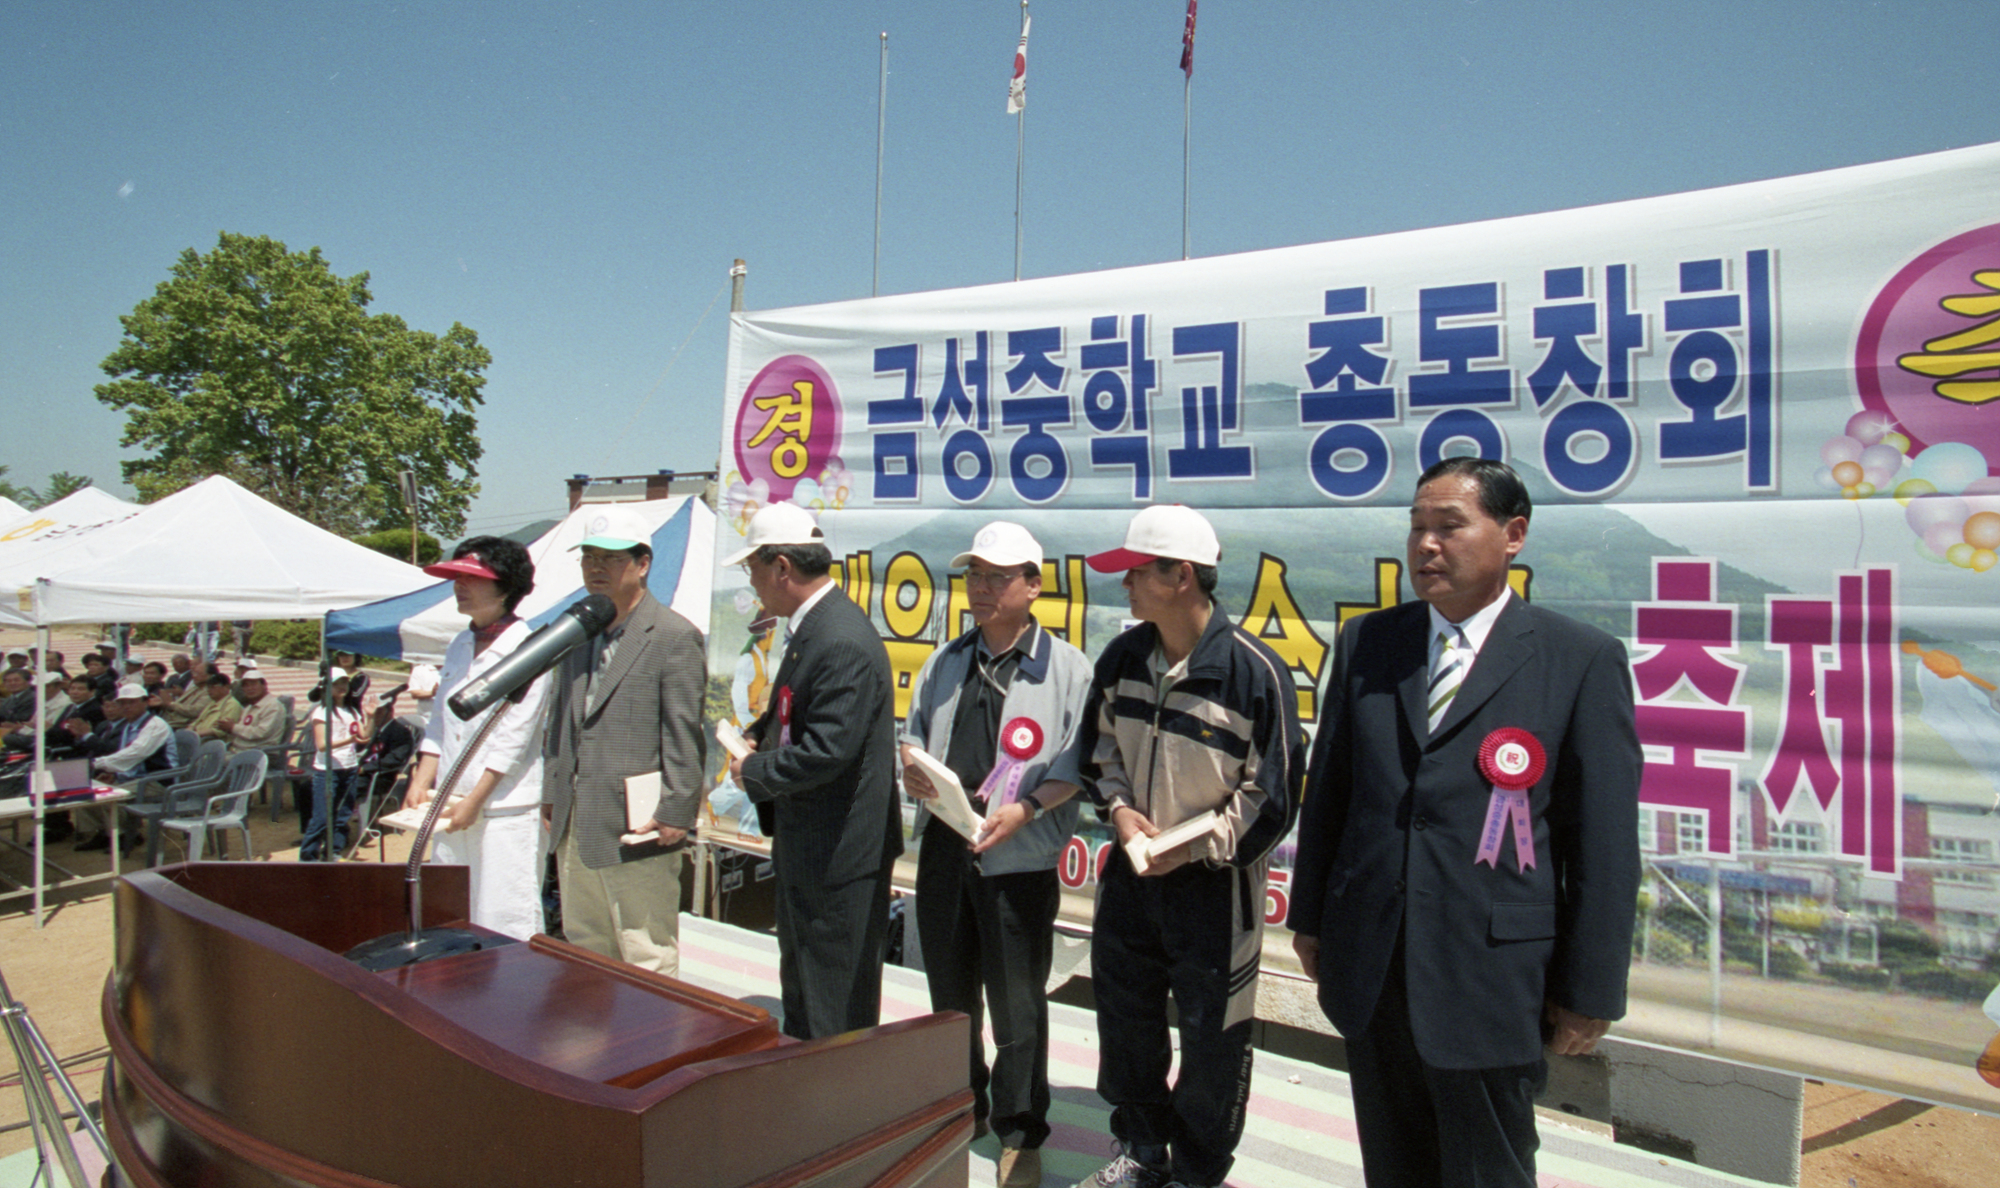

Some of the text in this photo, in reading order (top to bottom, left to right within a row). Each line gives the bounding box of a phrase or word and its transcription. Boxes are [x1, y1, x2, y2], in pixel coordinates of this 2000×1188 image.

[747, 380, 814, 479] 경
[867, 314, 1253, 502] 금성중학교
[1300, 249, 1771, 496] 총동창회
[1505, 751, 1520, 765] 祝
[1631, 562, 1897, 874] 축제
